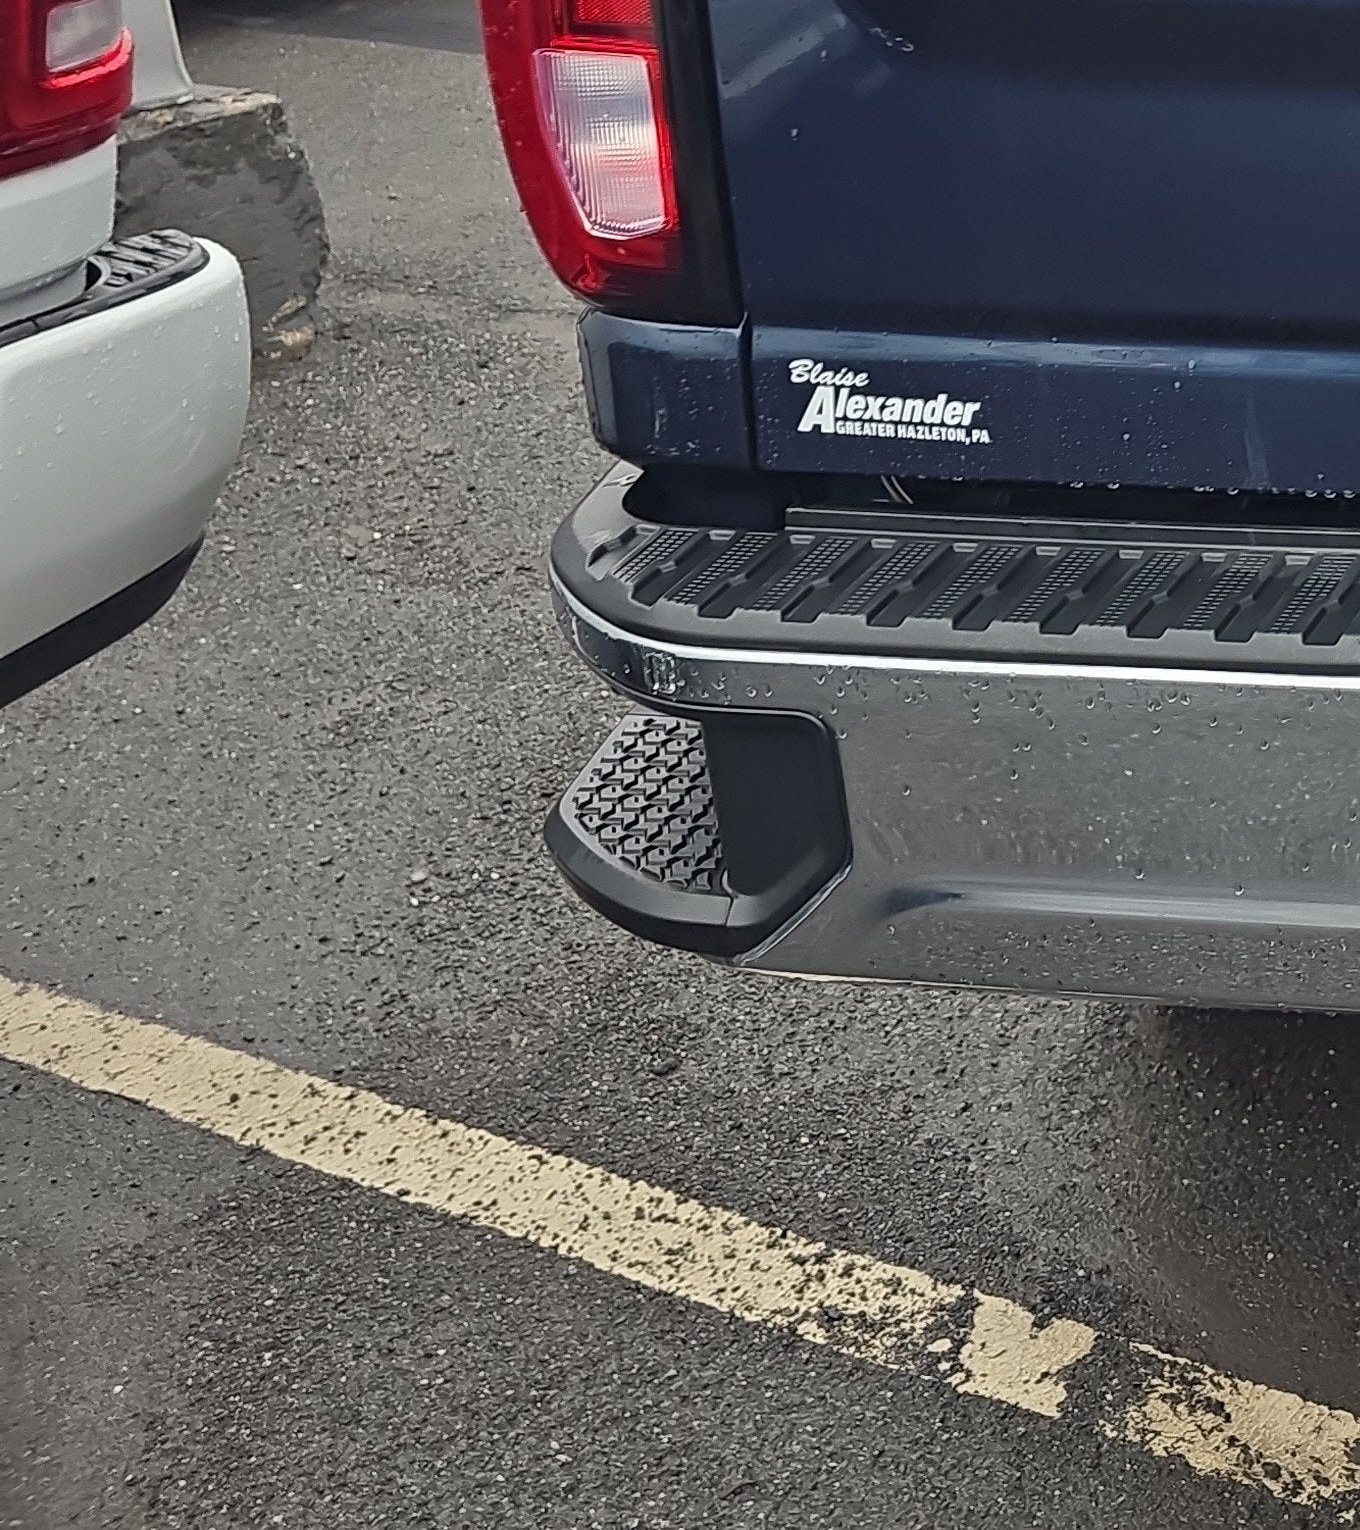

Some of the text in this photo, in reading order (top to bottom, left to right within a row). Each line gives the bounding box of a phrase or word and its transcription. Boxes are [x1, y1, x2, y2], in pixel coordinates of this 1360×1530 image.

[788, 358, 870, 387] Blaise
[798, 385, 982, 434] Alexander
[836, 421, 895, 438] GREATER
